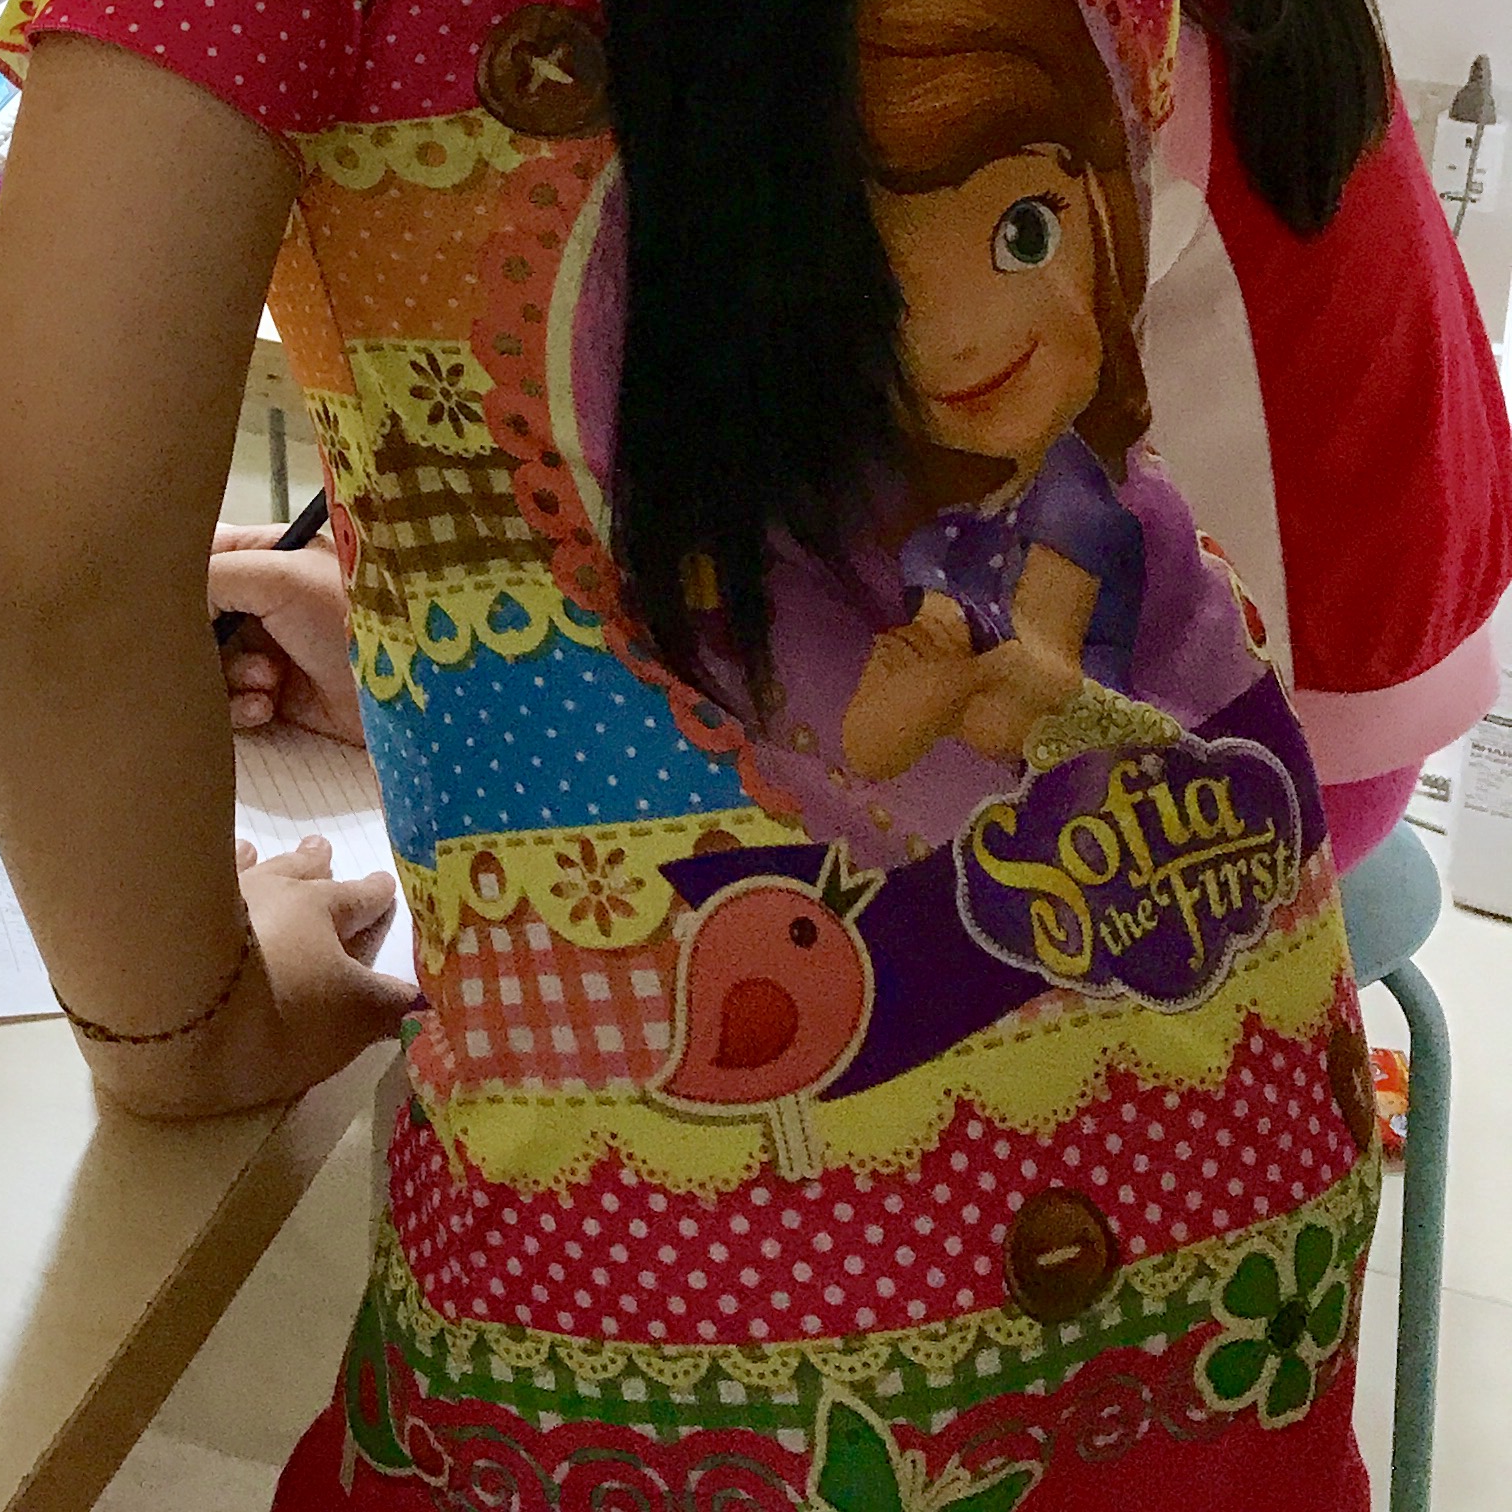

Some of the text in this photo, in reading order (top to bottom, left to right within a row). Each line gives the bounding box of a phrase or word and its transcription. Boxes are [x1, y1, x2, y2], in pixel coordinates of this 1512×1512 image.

[972, 759, 1246, 976] Sofia
[1099, 819, 1293, 970] the First
